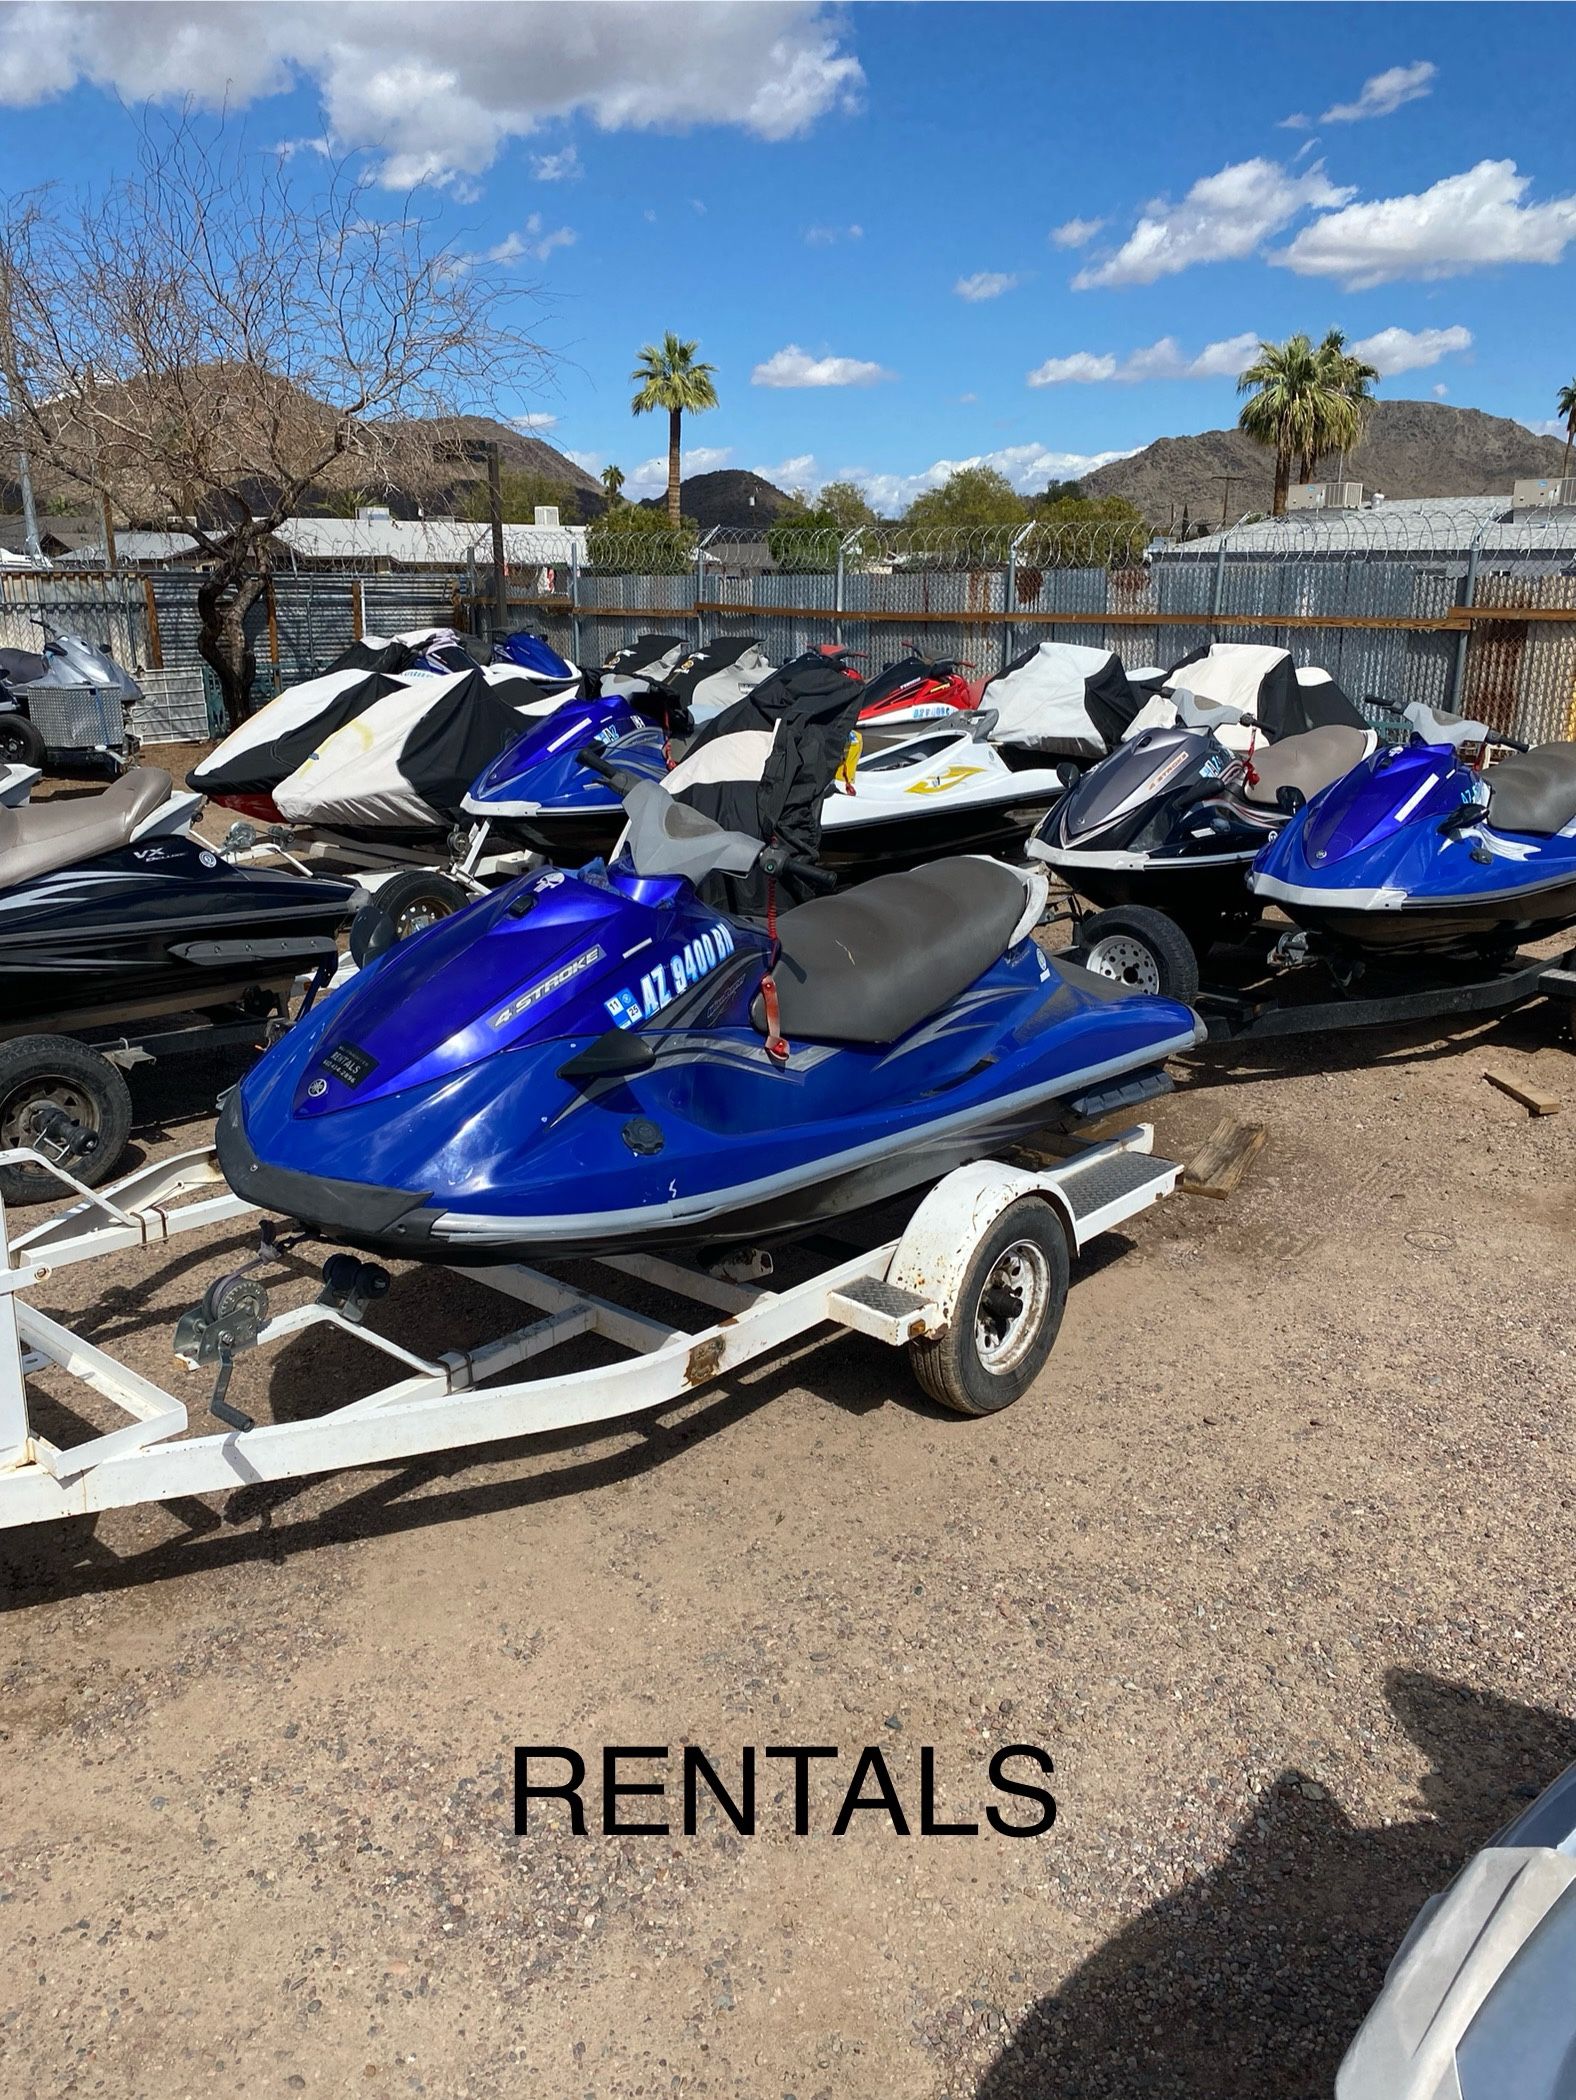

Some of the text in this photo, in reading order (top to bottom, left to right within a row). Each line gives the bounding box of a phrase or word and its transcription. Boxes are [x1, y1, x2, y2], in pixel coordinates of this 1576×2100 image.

[133, 847, 165, 859] VX
[640, 963, 673, 1020] AZ
[670, 933, 717, 994] 9400
[495, 948, 599, 1027] 4 STROKE
[609, 1000, 619, 1011] 11
[628, 1004, 639, 1018] 25
[330, 1051, 361, 1074] RENTALS
